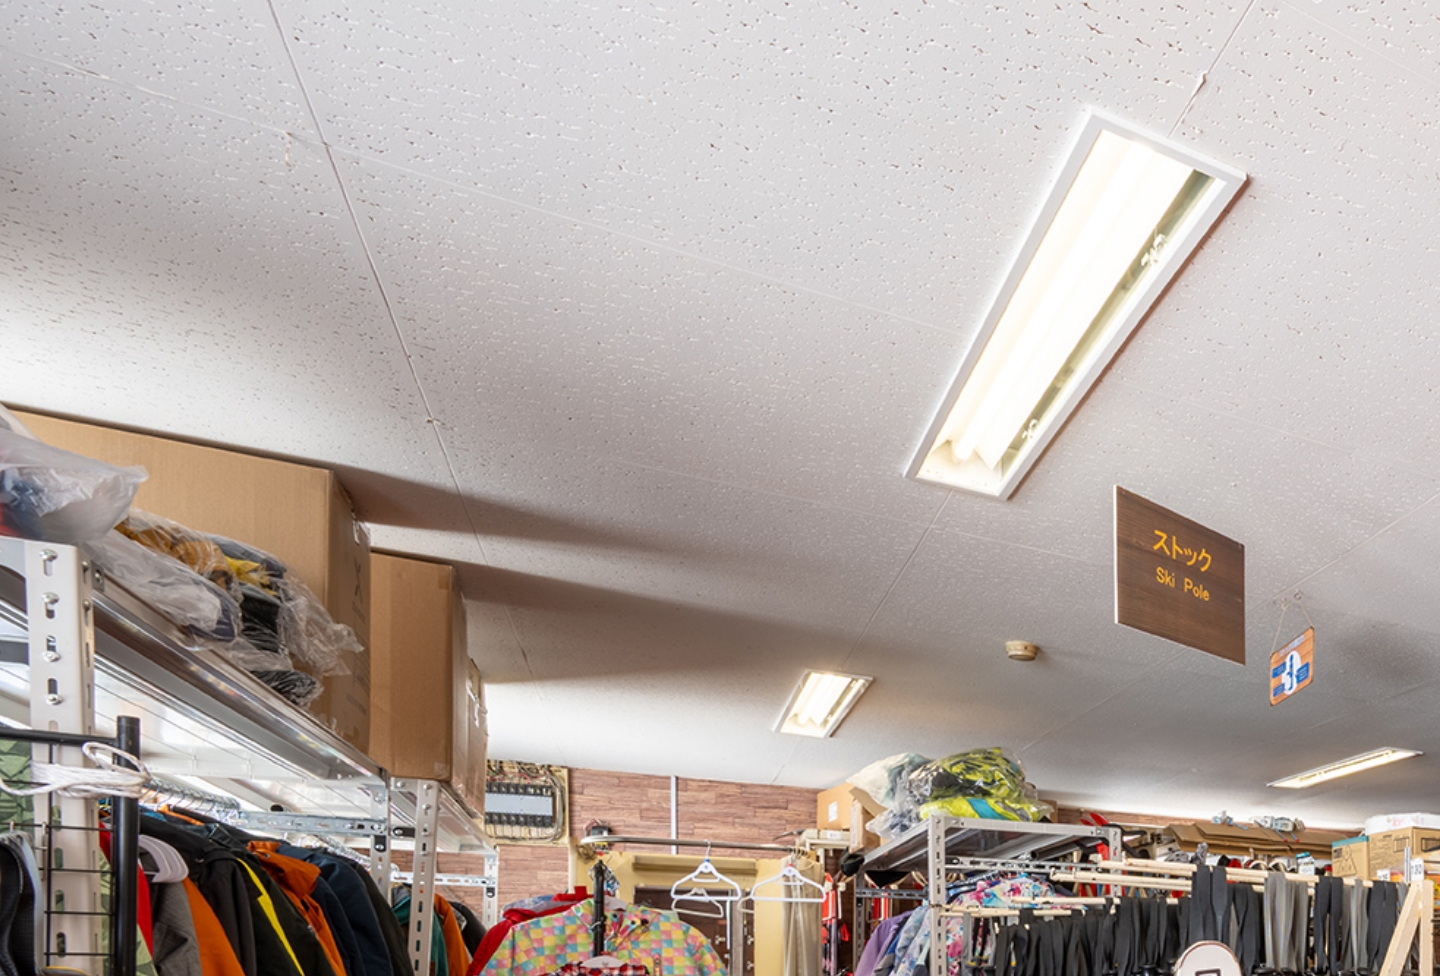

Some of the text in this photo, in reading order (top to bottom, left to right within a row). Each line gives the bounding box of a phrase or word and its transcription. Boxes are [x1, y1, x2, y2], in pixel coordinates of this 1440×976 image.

[1153, 529, 1212, 572] ストック
[1156, 566, 1210, 601] Ski Pole
